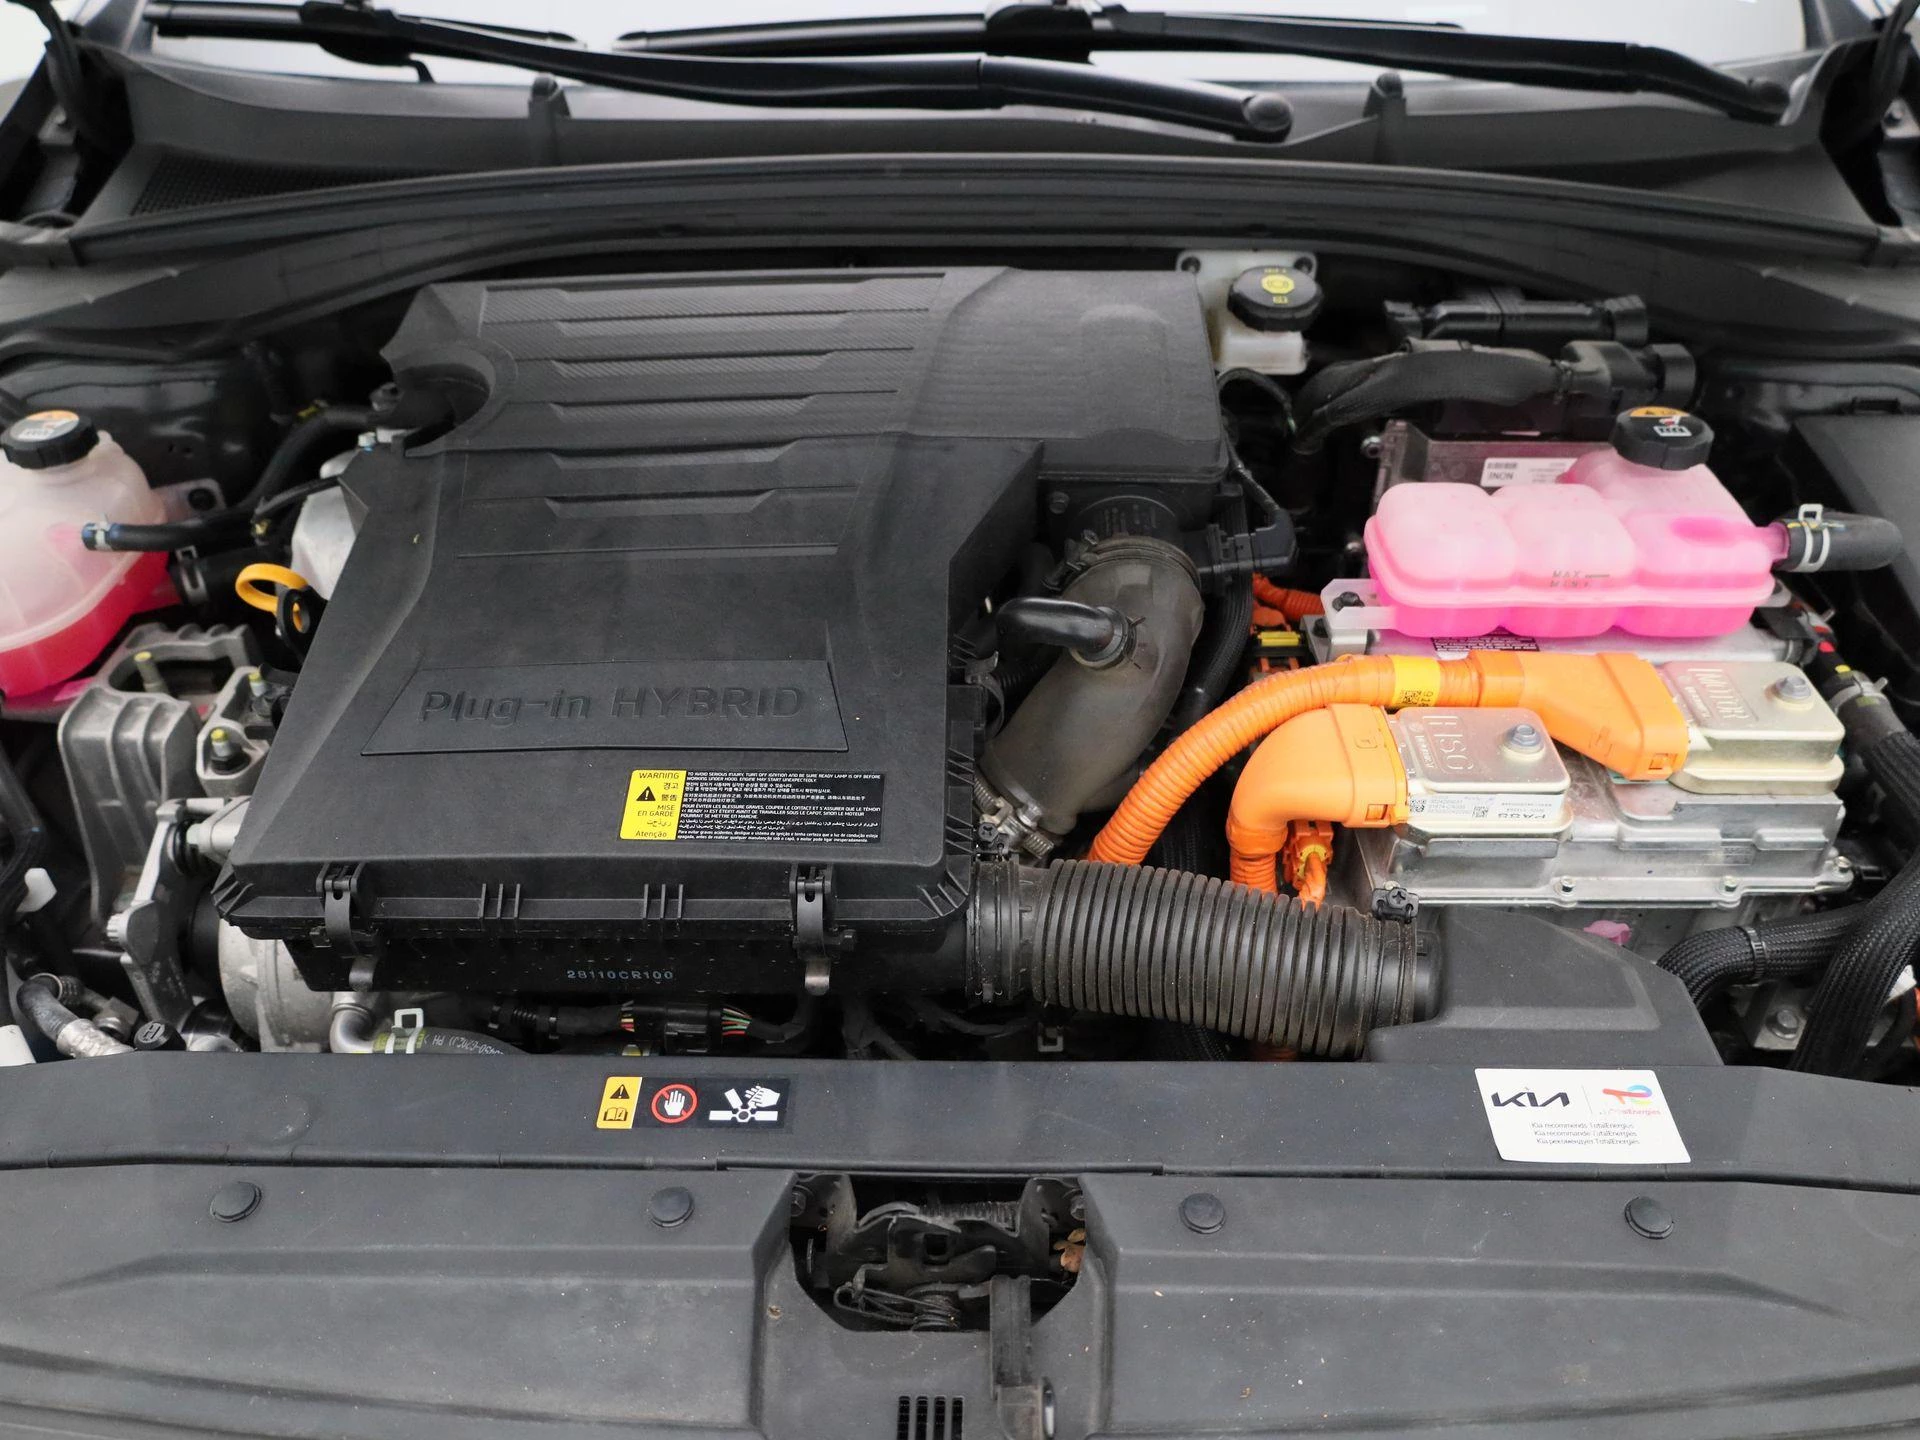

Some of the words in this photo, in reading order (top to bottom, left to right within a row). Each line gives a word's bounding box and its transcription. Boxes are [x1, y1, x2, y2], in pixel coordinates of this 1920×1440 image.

[416, 690, 590, 726] Plug-in
[611, 687, 808, 719] HYBRID
[664, 782, 678, 790] 경고
[635, 830, 667, 838] Atenção
[567, 970, 673, 979] 28110CR100
[1491, 1091, 1570, 1107] KIA
